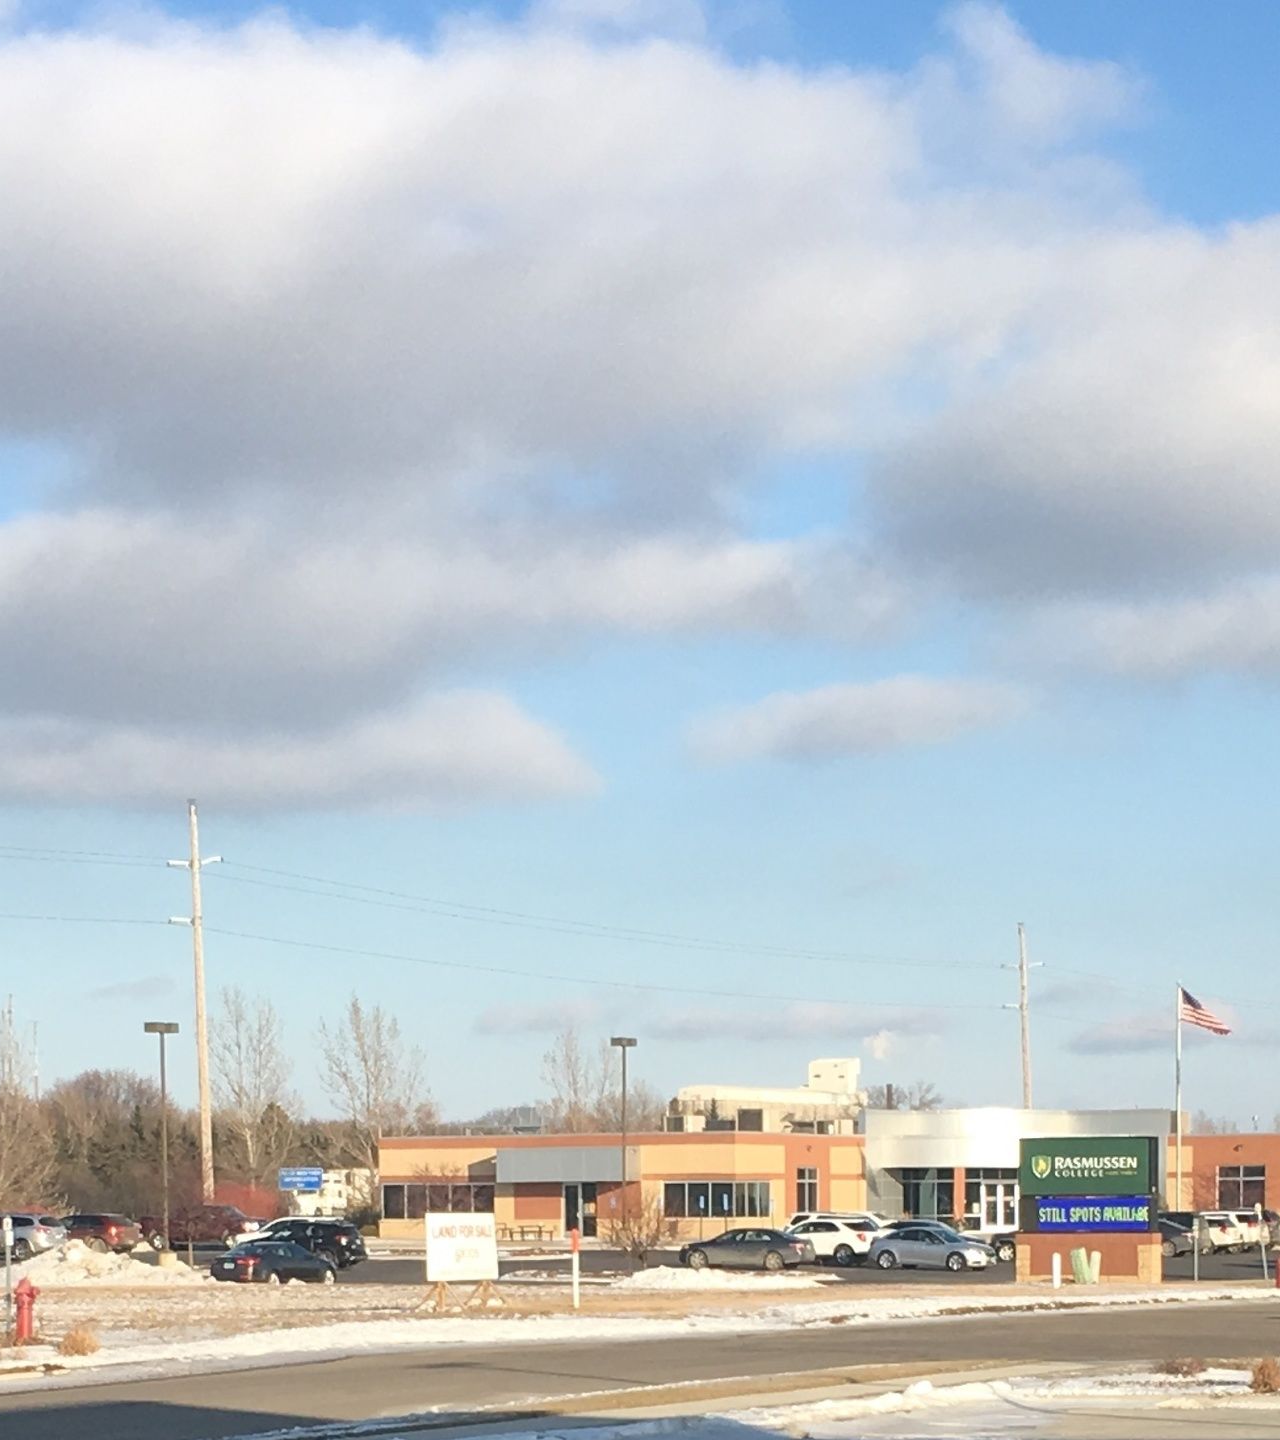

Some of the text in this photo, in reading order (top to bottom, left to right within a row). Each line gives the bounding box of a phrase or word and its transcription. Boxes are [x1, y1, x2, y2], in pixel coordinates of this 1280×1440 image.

[1054, 1156, 1137, 1169] RASMUSSEN
[1054, 1169, 1104, 1178] COLLEGE
[1038, 1207, 1067, 1222] STILL
[1069, 1207, 1101, 1222] SPOTS
[432, 1225, 457, 1239] LAND
[459, 1225, 473, 1238] FOR
